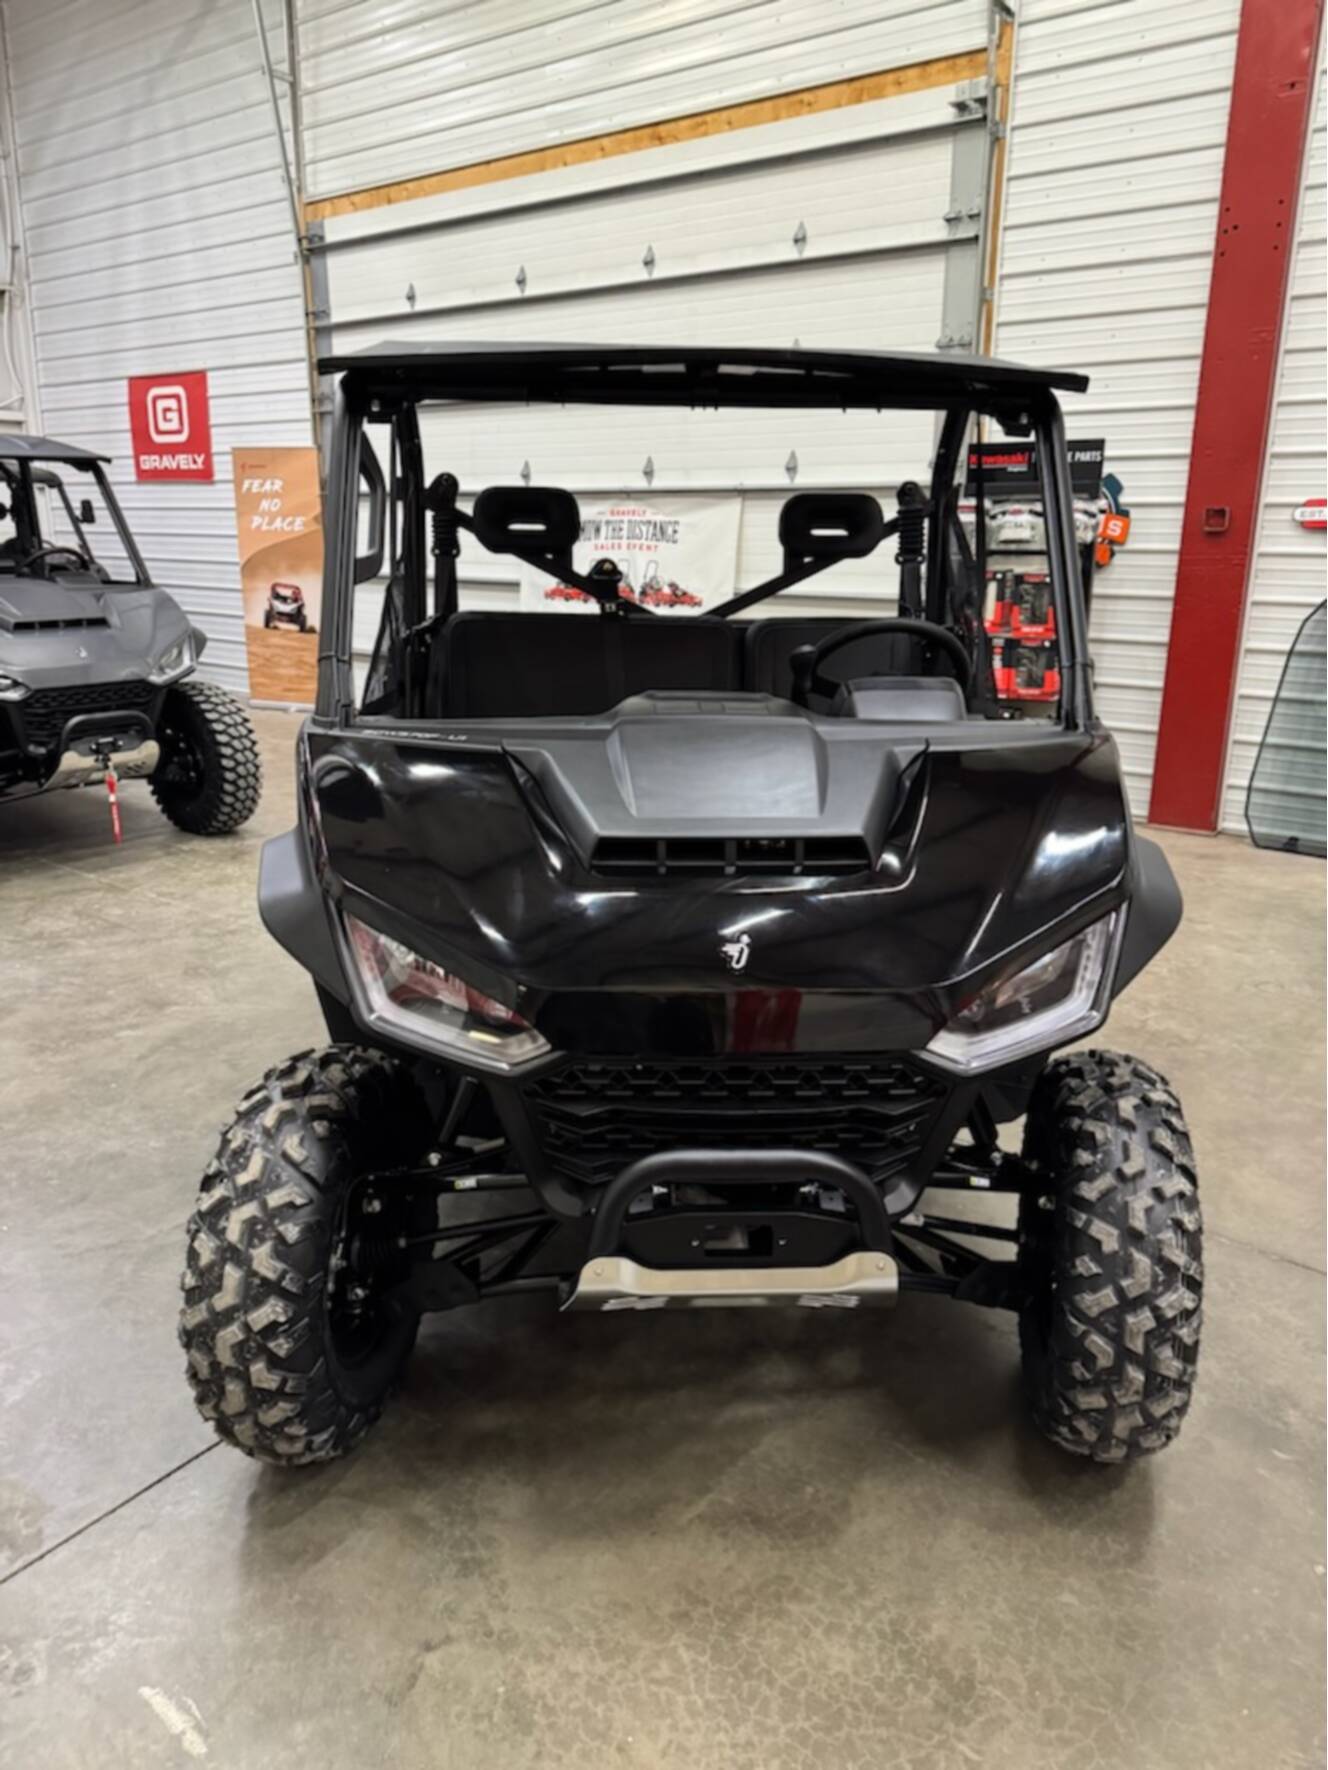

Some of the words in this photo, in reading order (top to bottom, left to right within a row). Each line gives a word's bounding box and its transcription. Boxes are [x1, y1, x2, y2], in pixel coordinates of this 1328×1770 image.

[139, 453, 205, 470] GRAVELY
[969, 452, 1029, 465] Kwasaki
[1074, 451, 1102, 462] PARTS
[242, 479, 283, 494] FEAR
[259, 498, 281, 512] NO
[251, 516, 305, 532] PLACE
[604, 519, 624, 540] THE
[626, 519, 680, 544] DISTANCE
[593, 542, 622, 551] SALES
